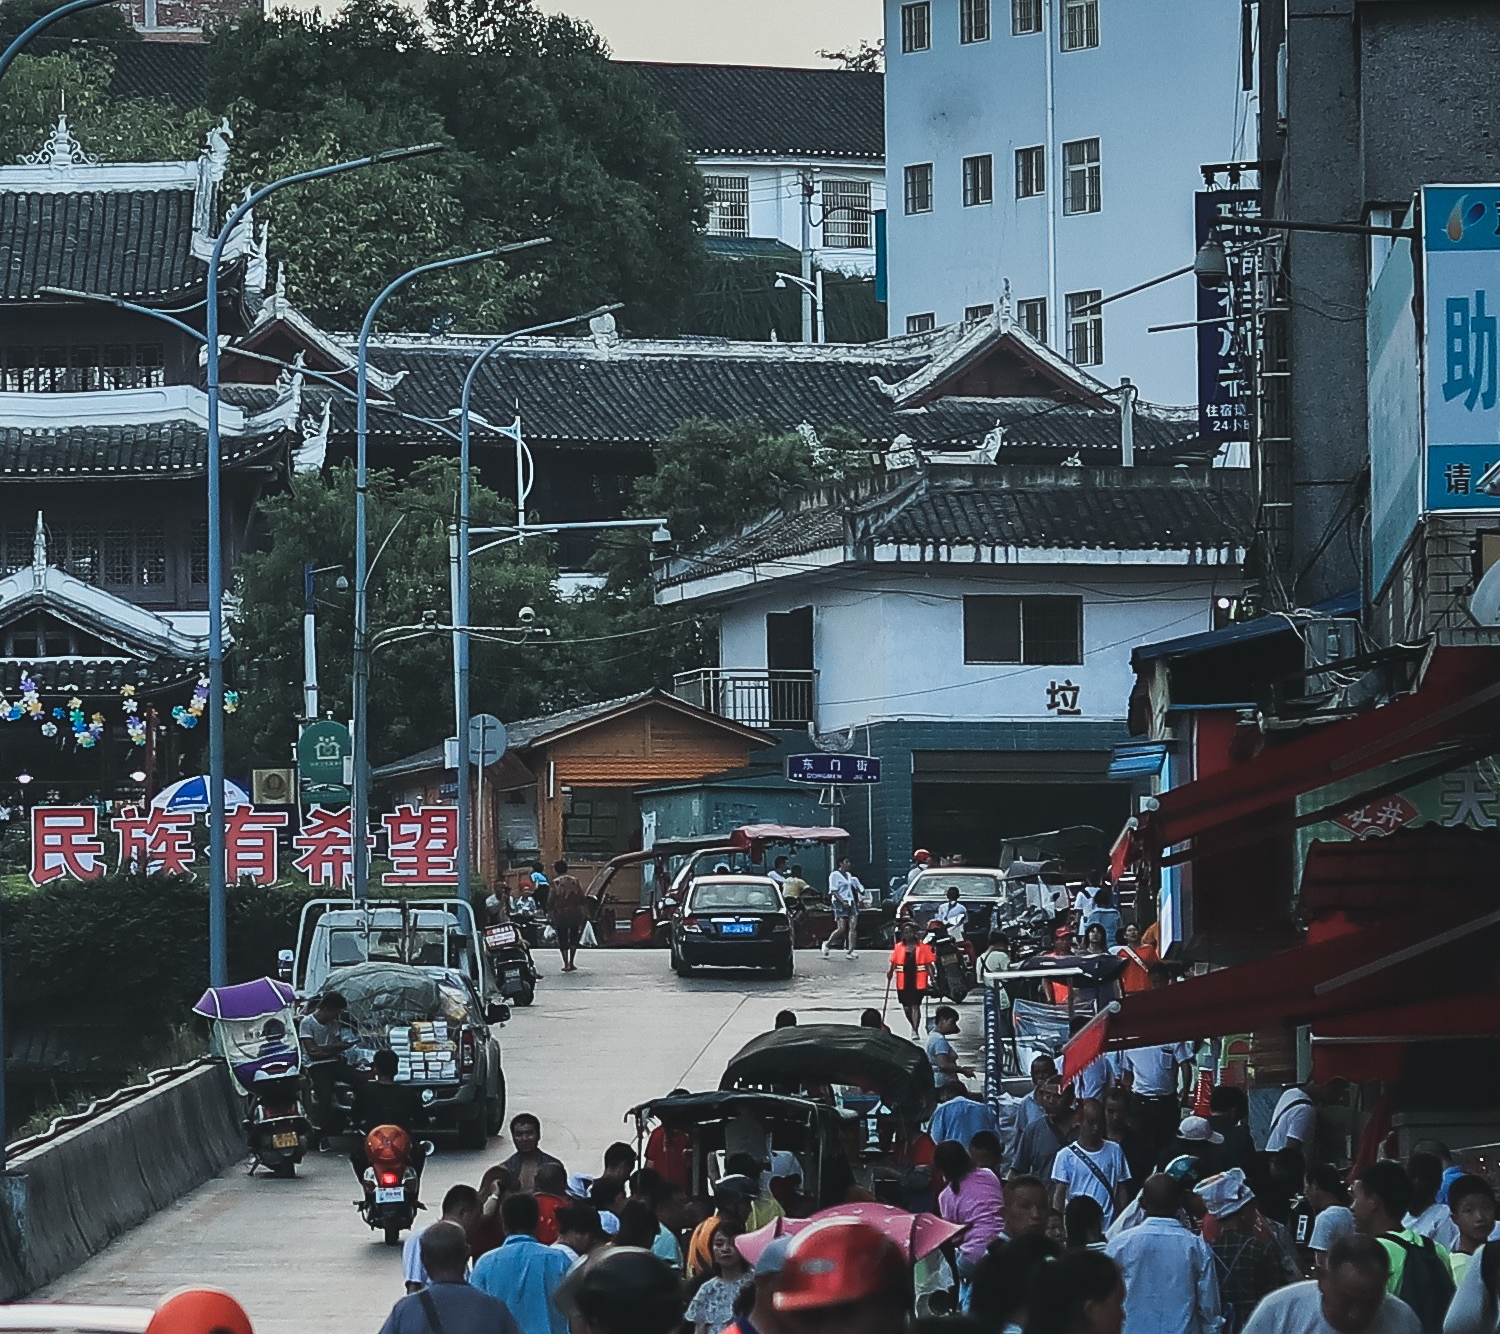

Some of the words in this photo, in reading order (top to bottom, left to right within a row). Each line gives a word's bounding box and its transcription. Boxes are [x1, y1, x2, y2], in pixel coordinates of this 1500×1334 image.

[1046, 678, 1082, 716] 垃
[801, 757, 868, 772] 东门街
[29, 803, 462, 889] 民族有希望
